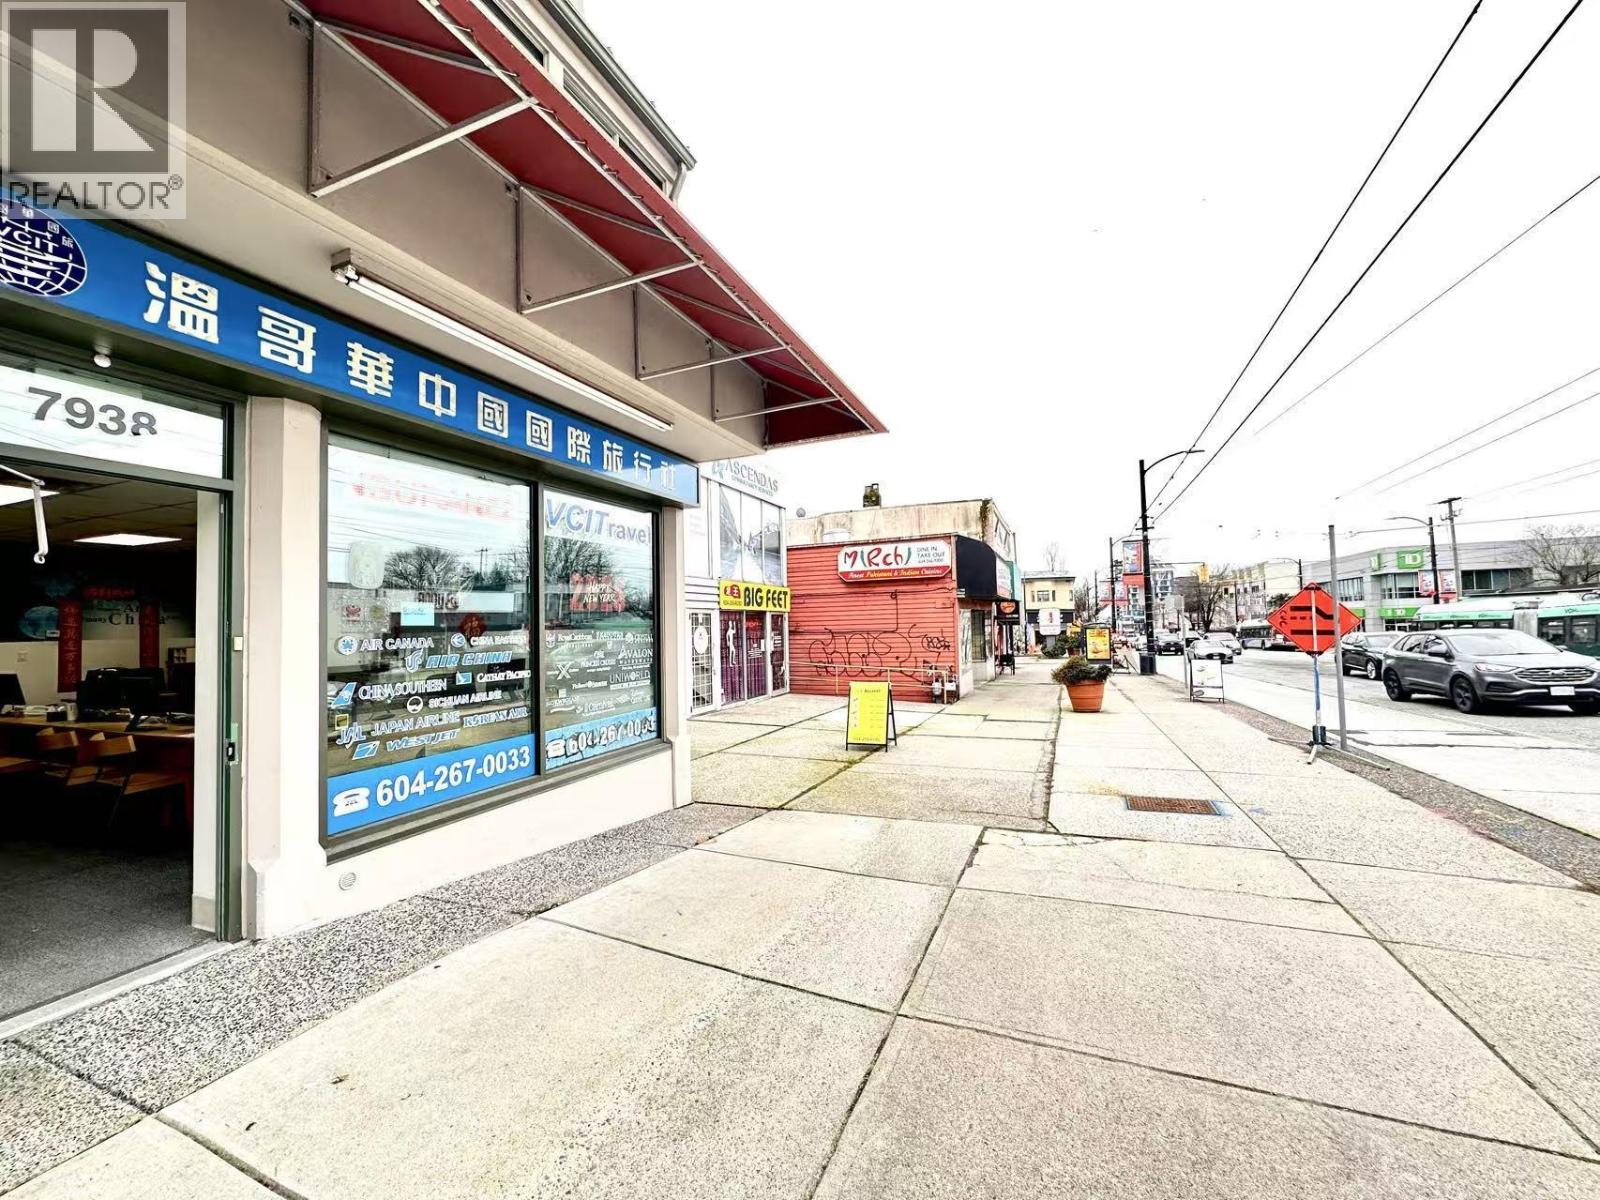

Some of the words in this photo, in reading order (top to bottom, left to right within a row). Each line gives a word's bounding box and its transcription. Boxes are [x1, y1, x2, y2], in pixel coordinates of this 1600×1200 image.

[28, 386, 158, 436] 7938
[726, 459, 779, 493] ASCENDAS
[1402, 553, 1422, 565] TD
[744, 586, 764, 607] BIG
[766, 588, 788, 609] FEET
[360, 638, 384, 651] AIR
[385, 637, 435, 650] CANADA
[618, 646, 653, 659] AVALON
[425, 653, 460, 668] AIR
[462, 650, 513, 666] CHINA
[609, 670, 650, 683] UNIWORLD
[428, 693, 470, 708] SICHUAN
[508, 706, 529, 719] AIR
[370, 720, 414, 737] JAPAN
[415, 711, 461, 729] AIRLINE
[386, 728, 461, 752] WESTJET
[376, 745, 531, 807] 604-267-0033
